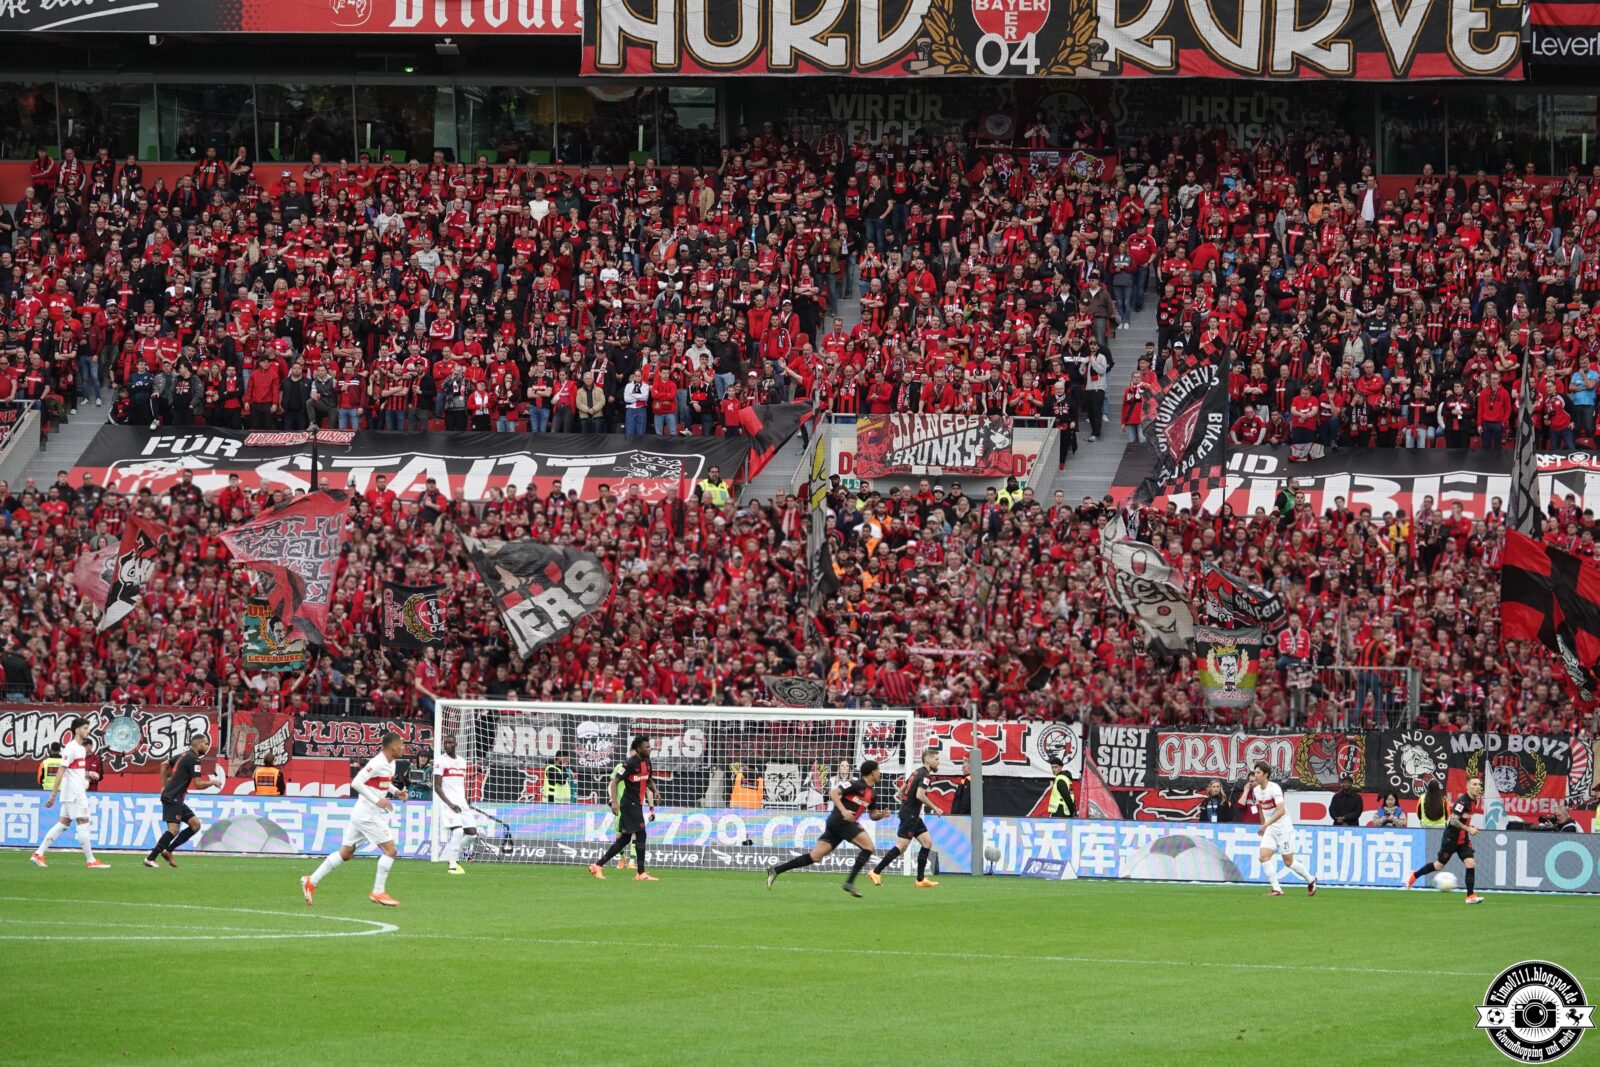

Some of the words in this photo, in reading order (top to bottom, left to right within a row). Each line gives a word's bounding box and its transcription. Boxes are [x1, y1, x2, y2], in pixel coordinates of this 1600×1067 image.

[975, 32, 1041, 76] 04
[1532, 31, 1600, 56] Lever
[828, 93, 885, 121] WIR
[888, 88, 944, 121] FÜR
[1181, 96, 1230, 123] IHR
[1233, 91, 1290, 124] FÜR
[141, 434, 244, 458] FÜR
[891, 428, 978, 467] SKUNKS
[254, 453, 617, 501] STADT
[0, 712, 100, 759] CHAOS
[148, 714, 211, 759] 513
[1099, 726, 1150, 747] WEST
[1450, 733, 1502, 754] MAD
[1507, 734, 1570, 762] BOYZ
[305, 743, 431, 758] LEVERKEN
[1097, 746, 1147, 769] SIDE
[1384, 731, 1436, 793] COMMANDO
[1433, 745, 1449, 781] 1989
[1101, 767, 1146, 787] BOYZ
[654, 850, 699, 864] trive
[734, 852, 780, 866] trive
[1495, 833, 1600, 890] iLO
